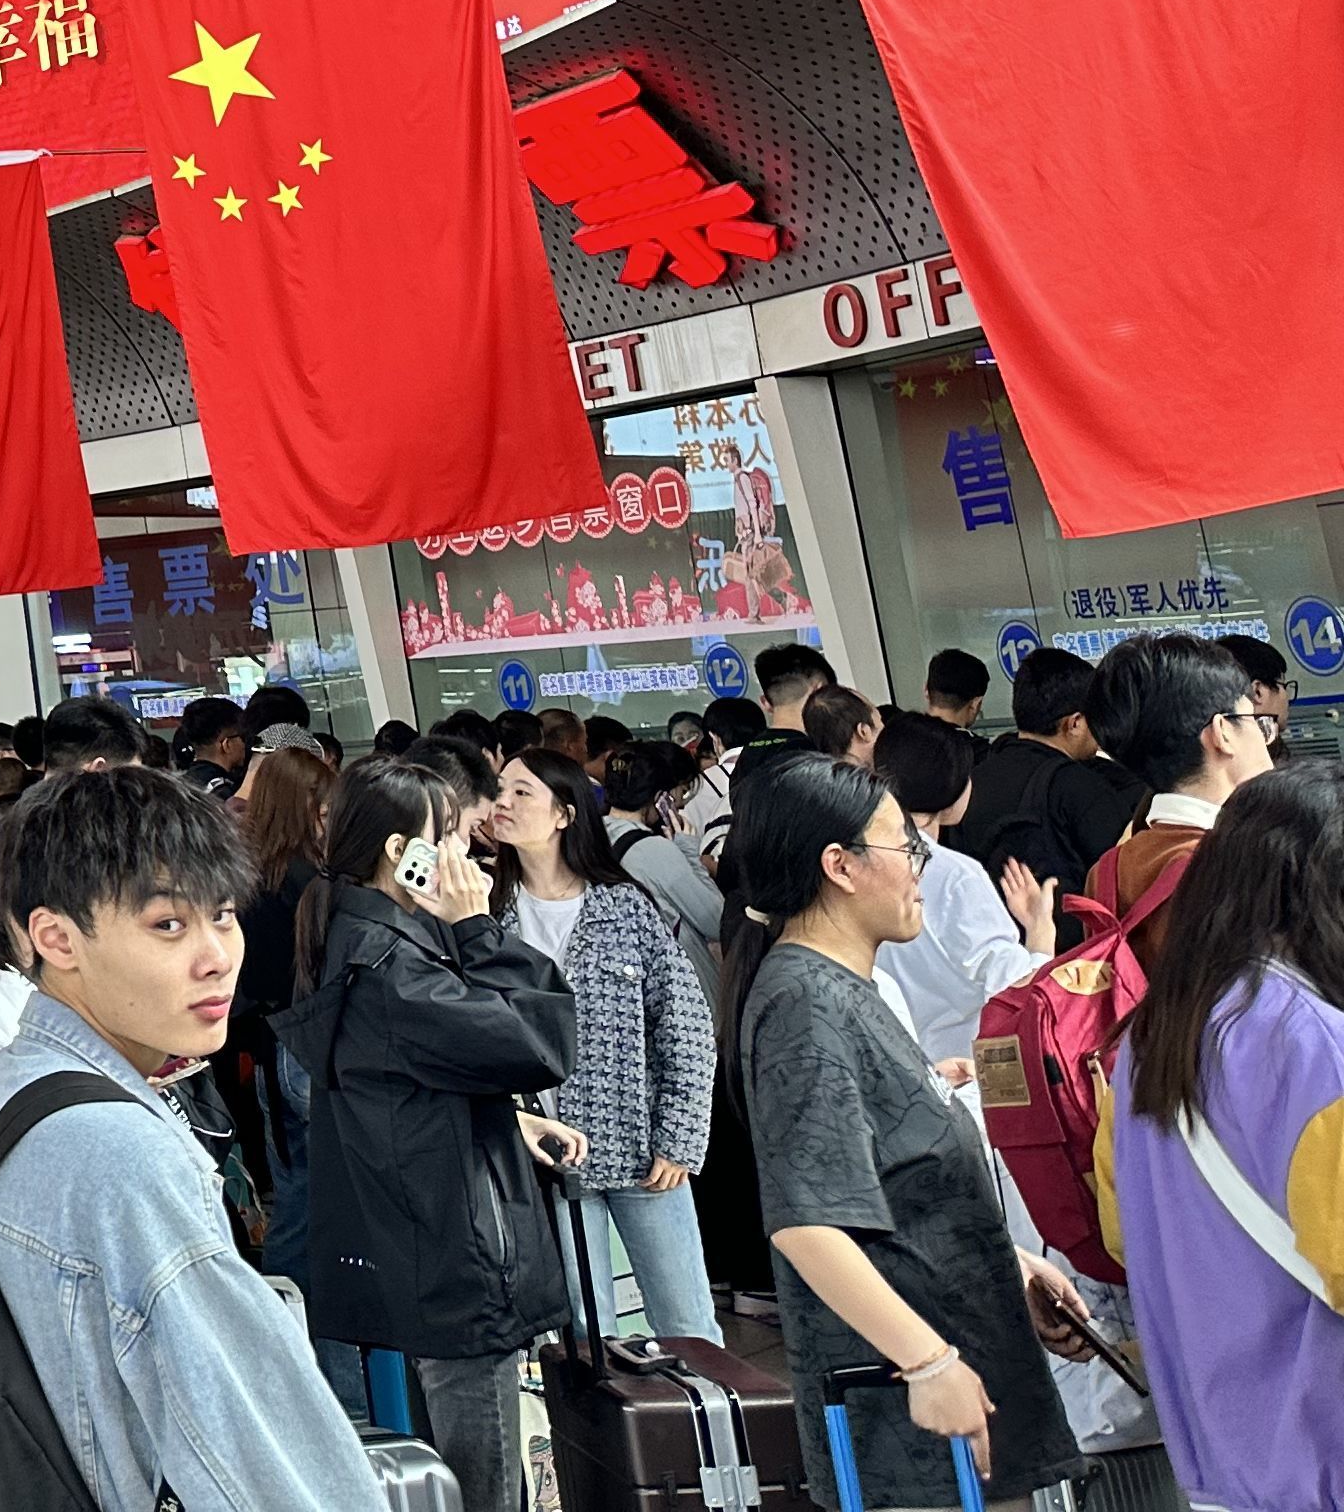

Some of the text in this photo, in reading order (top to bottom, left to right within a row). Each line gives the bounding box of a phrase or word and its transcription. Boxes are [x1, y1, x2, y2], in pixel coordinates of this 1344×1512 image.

[1291, 615, 1343, 657] 14
[503, 672, 530, 702] 11
[710, 657, 744, 689] 12
